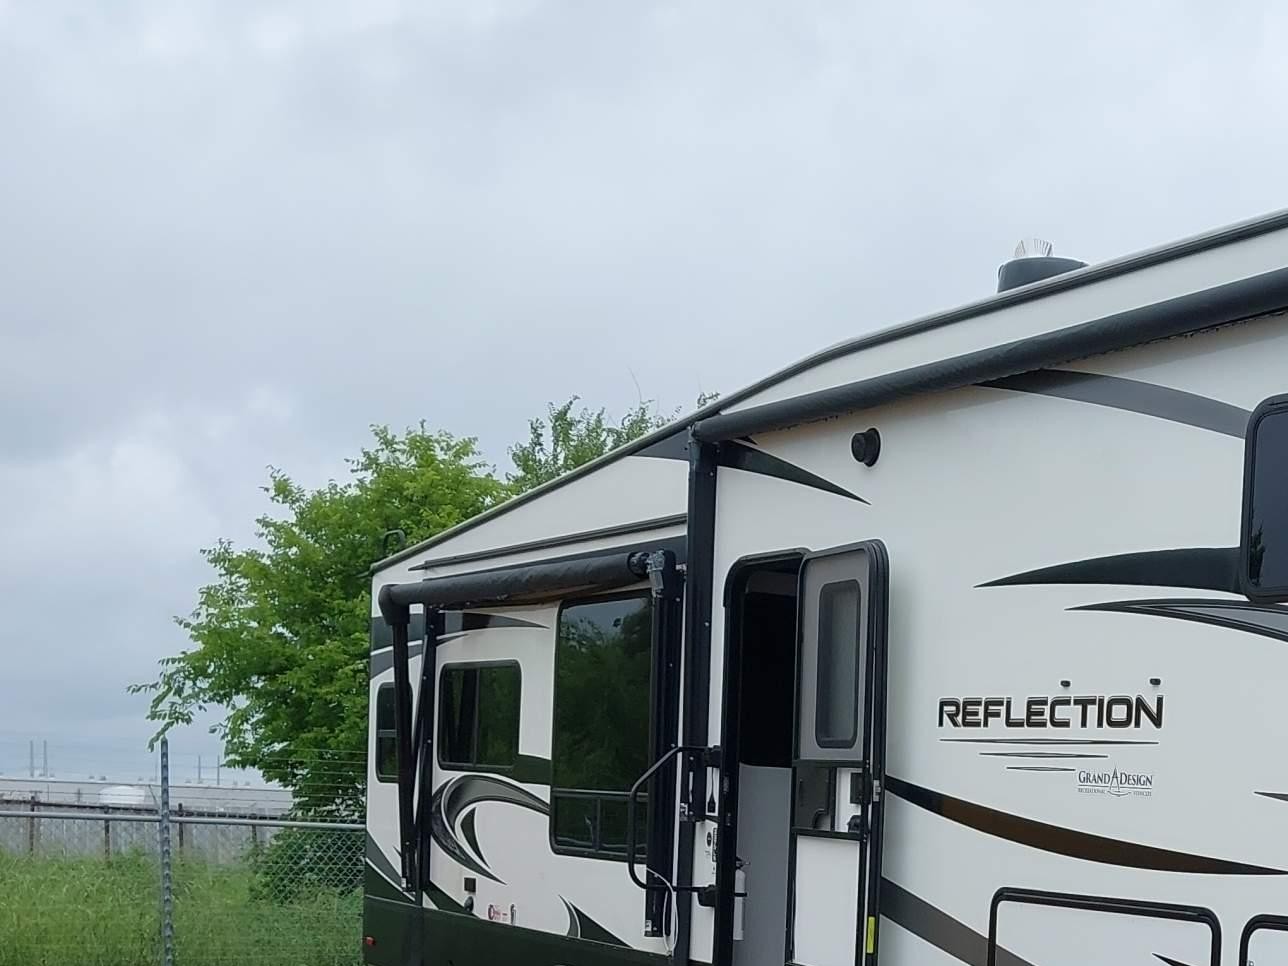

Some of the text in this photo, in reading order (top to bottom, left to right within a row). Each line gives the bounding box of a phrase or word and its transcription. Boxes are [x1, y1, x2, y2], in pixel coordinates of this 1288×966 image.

[937, 694, 1164, 729] REFLECTION
[1078, 770, 1153, 786] GRAND DESIGN
